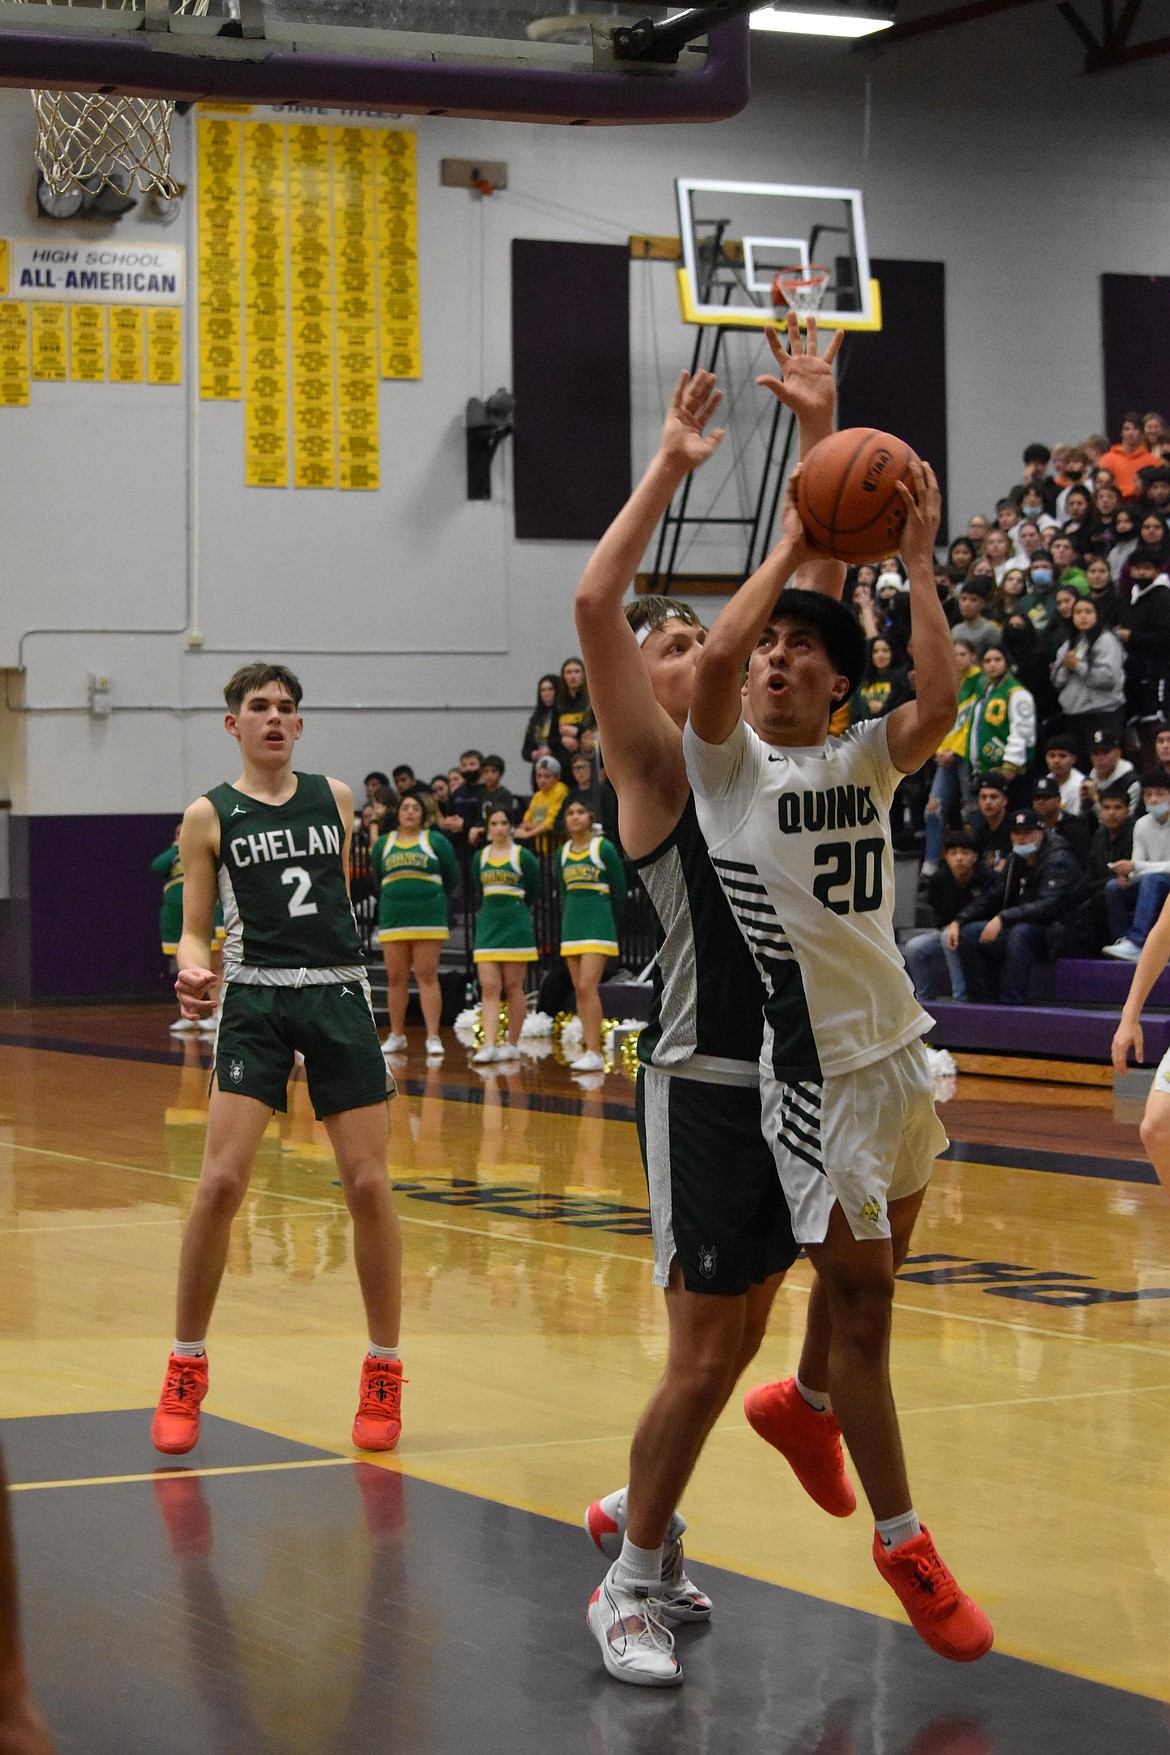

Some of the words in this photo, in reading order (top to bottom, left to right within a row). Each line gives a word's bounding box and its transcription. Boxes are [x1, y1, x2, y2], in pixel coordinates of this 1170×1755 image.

[32, 250, 78, 264] HIGH
[86, 252, 164, 268] SCHOOL
[229, 824, 340, 868] CHELAN
[280, 865, 319, 919] 2
[812, 837, 886, 916] 20
